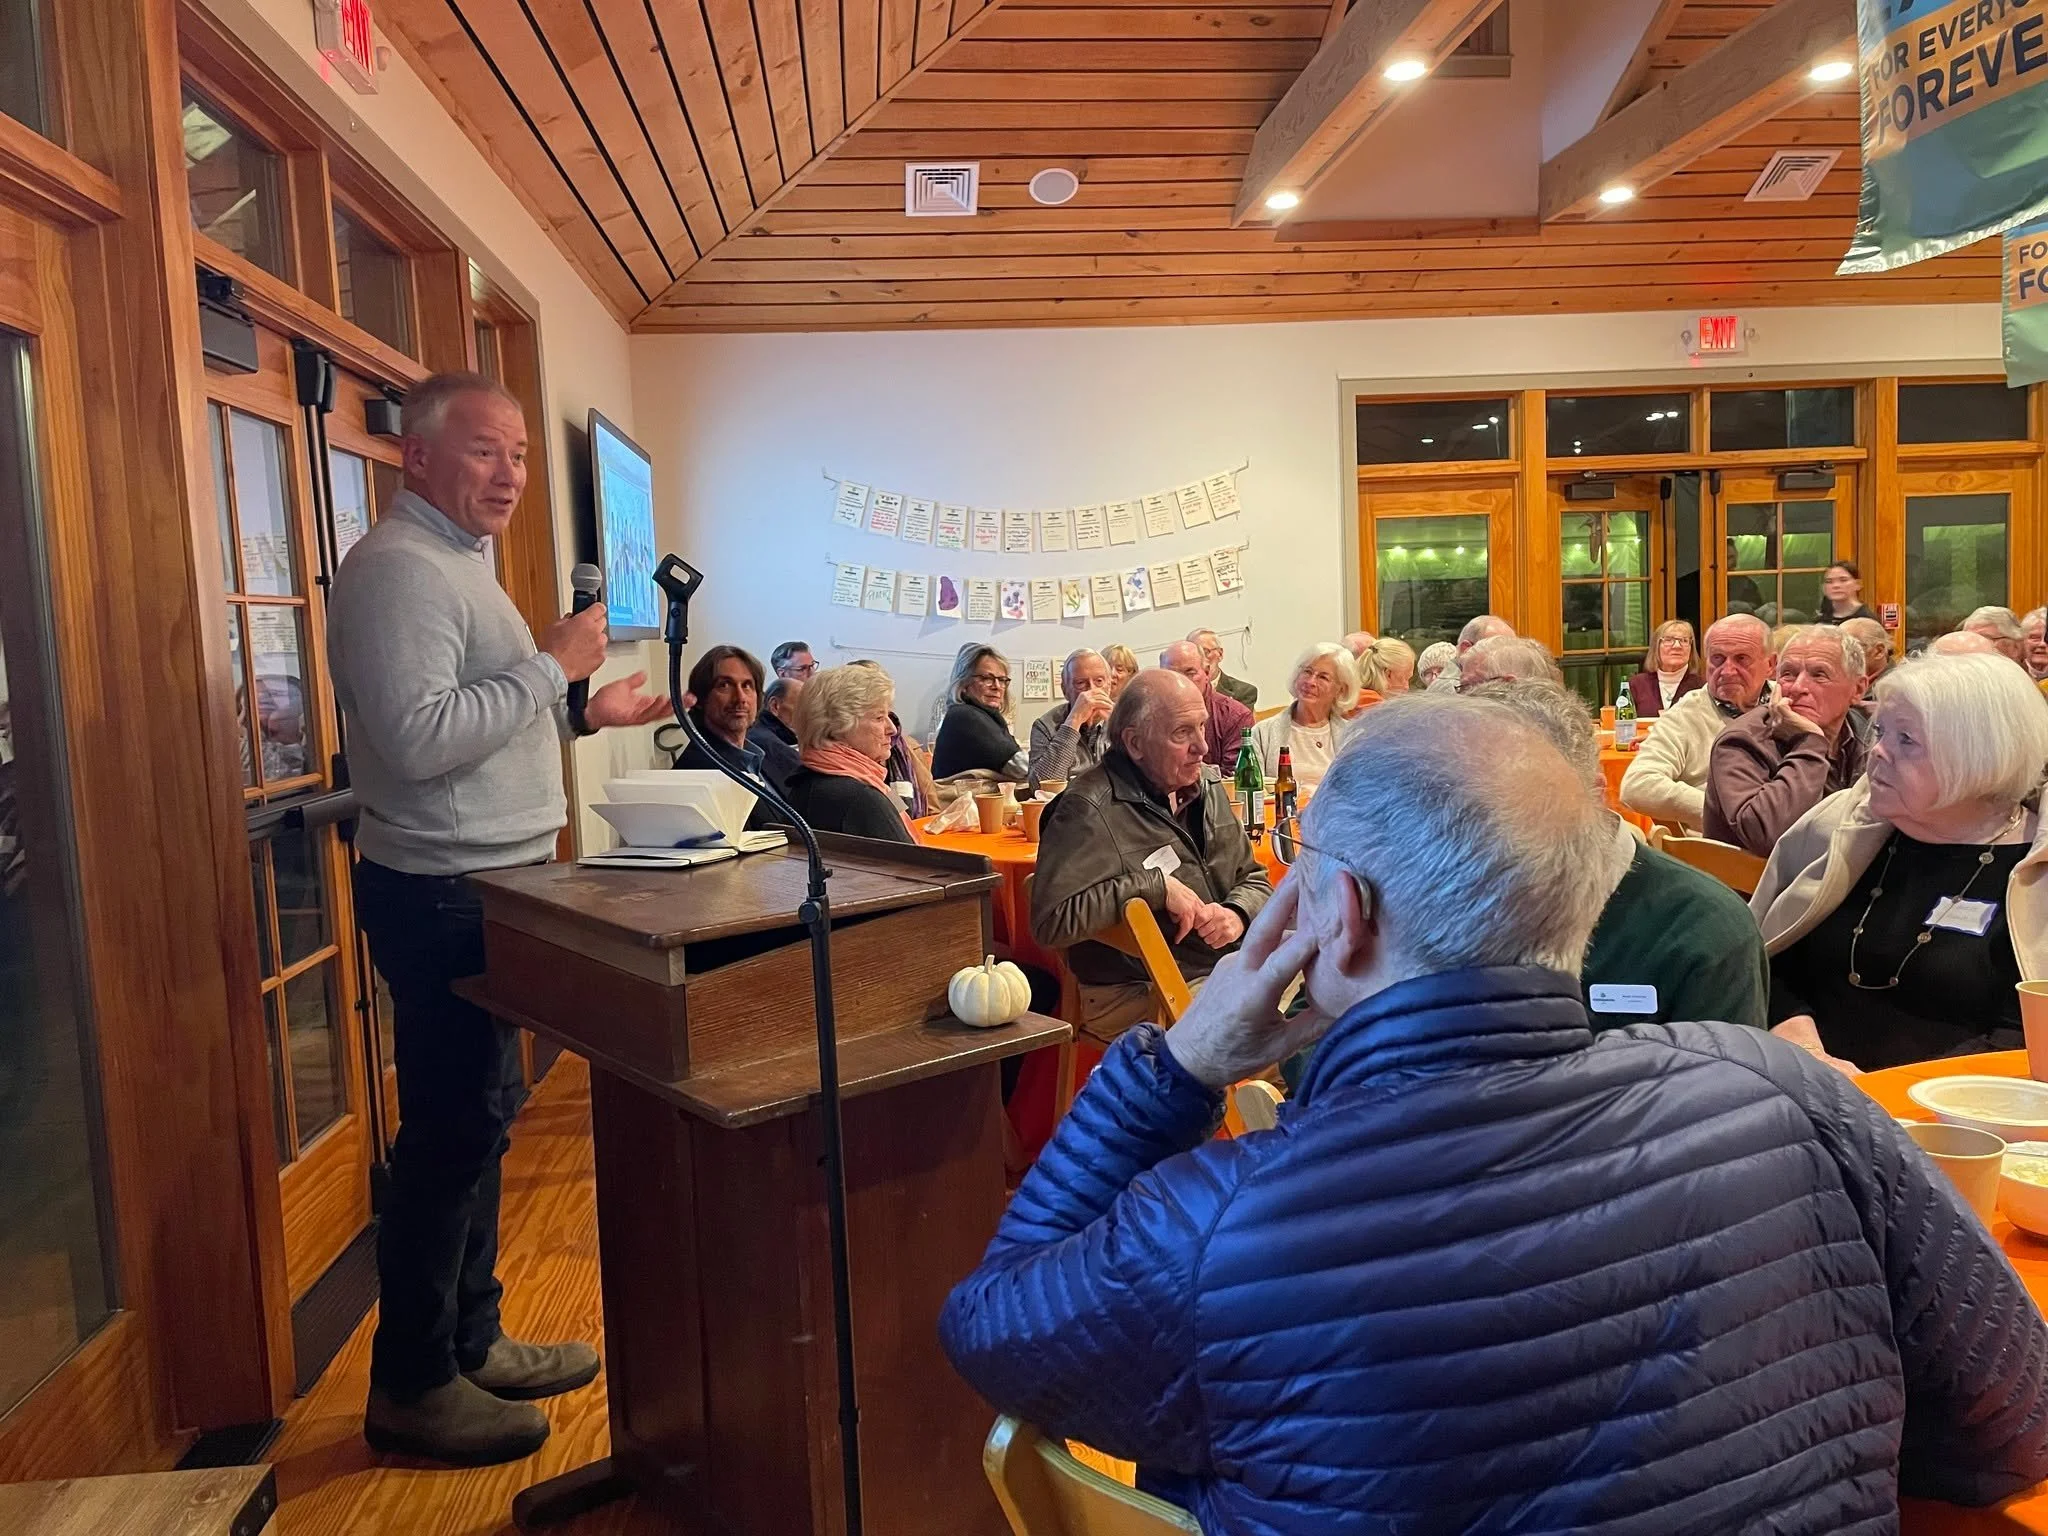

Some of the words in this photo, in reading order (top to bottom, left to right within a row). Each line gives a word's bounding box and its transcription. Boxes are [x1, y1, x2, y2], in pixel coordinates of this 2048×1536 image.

[1872, 41, 1910, 90] FOR
[1878, 13, 2048, 145] FOREVE
[1700, 315, 1736, 349] EXIT
